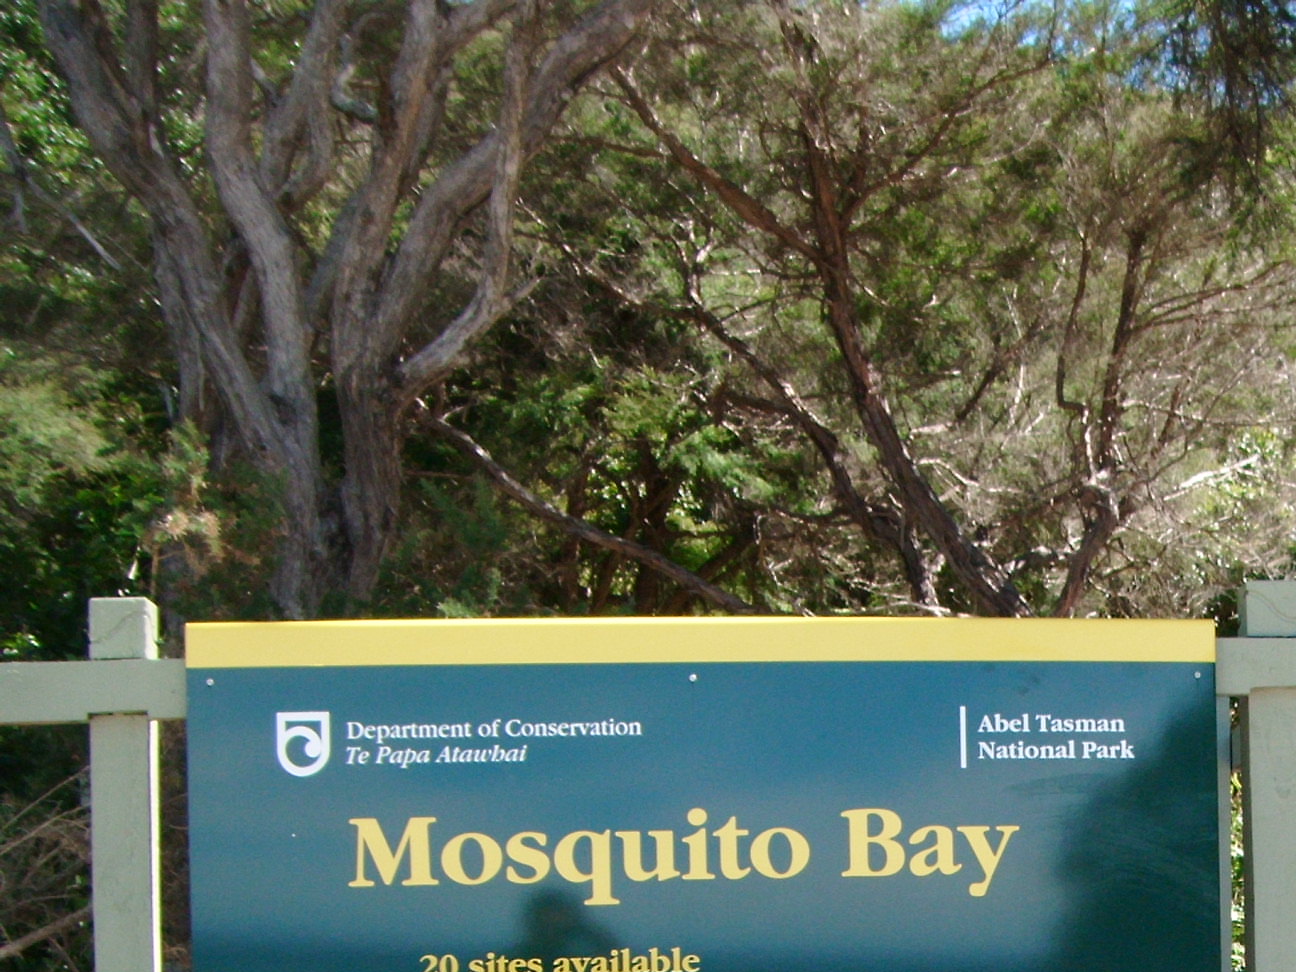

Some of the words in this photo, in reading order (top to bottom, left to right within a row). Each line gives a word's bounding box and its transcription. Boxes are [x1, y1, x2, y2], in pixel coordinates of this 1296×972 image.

[347, 721, 473, 744] Department
[478, 718, 502, 738] of
[505, 717, 642, 737] Conservation
[977, 713, 1031, 733] Abel
[1035, 713, 1126, 733] Tasman
[346, 746, 371, 765] Te
[375, 745, 431, 768] Papa
[435, 744, 528, 763] Atawhai
[977, 739, 1077, 760] National
[1081, 739, 1136, 759] Park
[347, 807, 811, 906] Mosquito
[840, 807, 1021, 898] Bay
